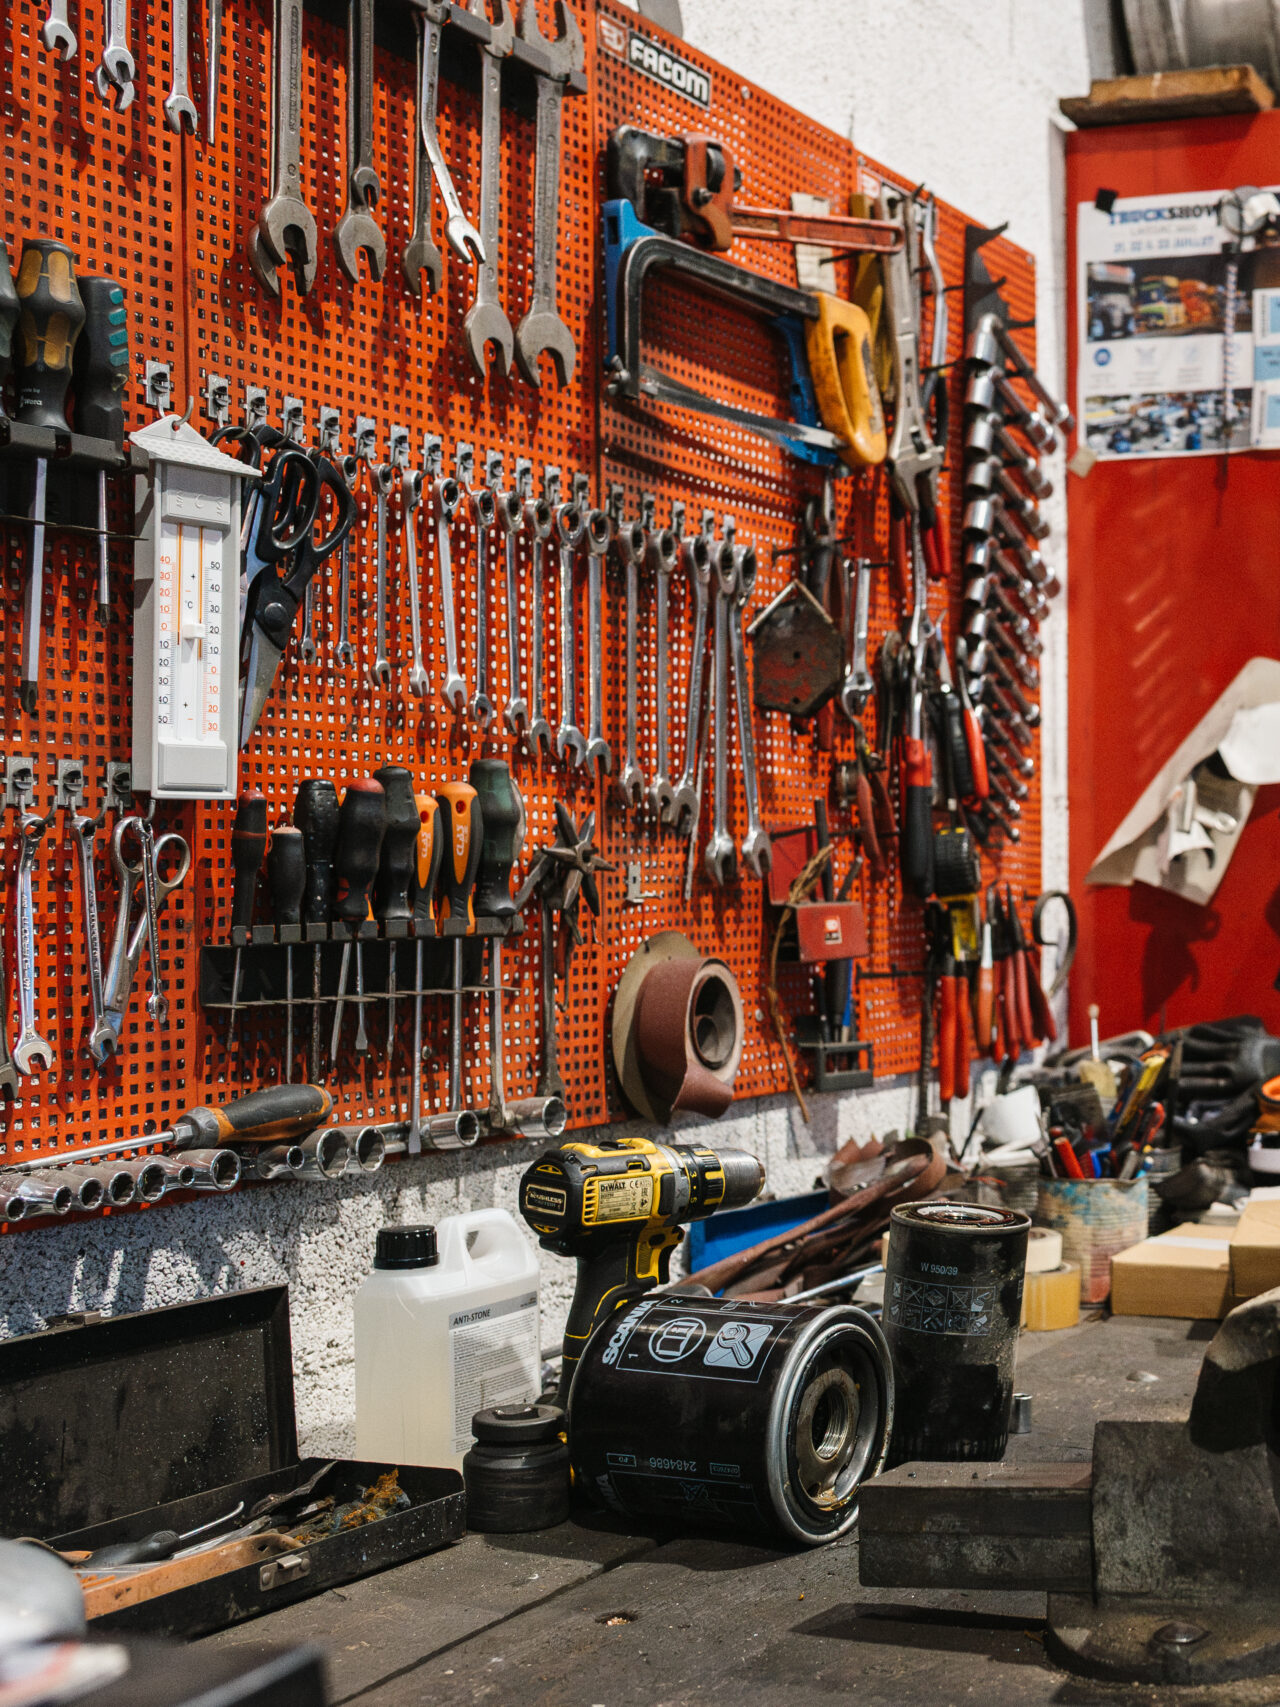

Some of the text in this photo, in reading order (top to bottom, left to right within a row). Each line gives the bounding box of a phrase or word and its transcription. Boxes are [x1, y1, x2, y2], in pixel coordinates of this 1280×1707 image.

[630, 38, 709, 103] FACOM
[160, 555, 171, 565] 40
[210, 561, 221, 570] 50
[160, 572, 171, 580] 30
[160, 588, 170, 597] 20
[210, 584, 221, 592] 40
[160, 605, 170, 613] 10
[209, 605, 220, 613] 30
[209, 626, 220, 634] 20
[160, 641, 169, 649] 10
[210, 646, 219, 654] 10
[159, 658, 169, 667] 20
[159, 677, 169, 685] 30
[209, 685, 219, 693] 10
[208, 704, 219, 713] 20
[207, 722, 218, 731] 30
[456, 824, 465, 856] CLAS
[920, 1262, 959, 1276] W 950/39
[453, 1308, 491, 1326] ANTI-STONE
[602, 1300, 660, 1365] SCANIA
[649, 1456, 697, 1472] 2484686
